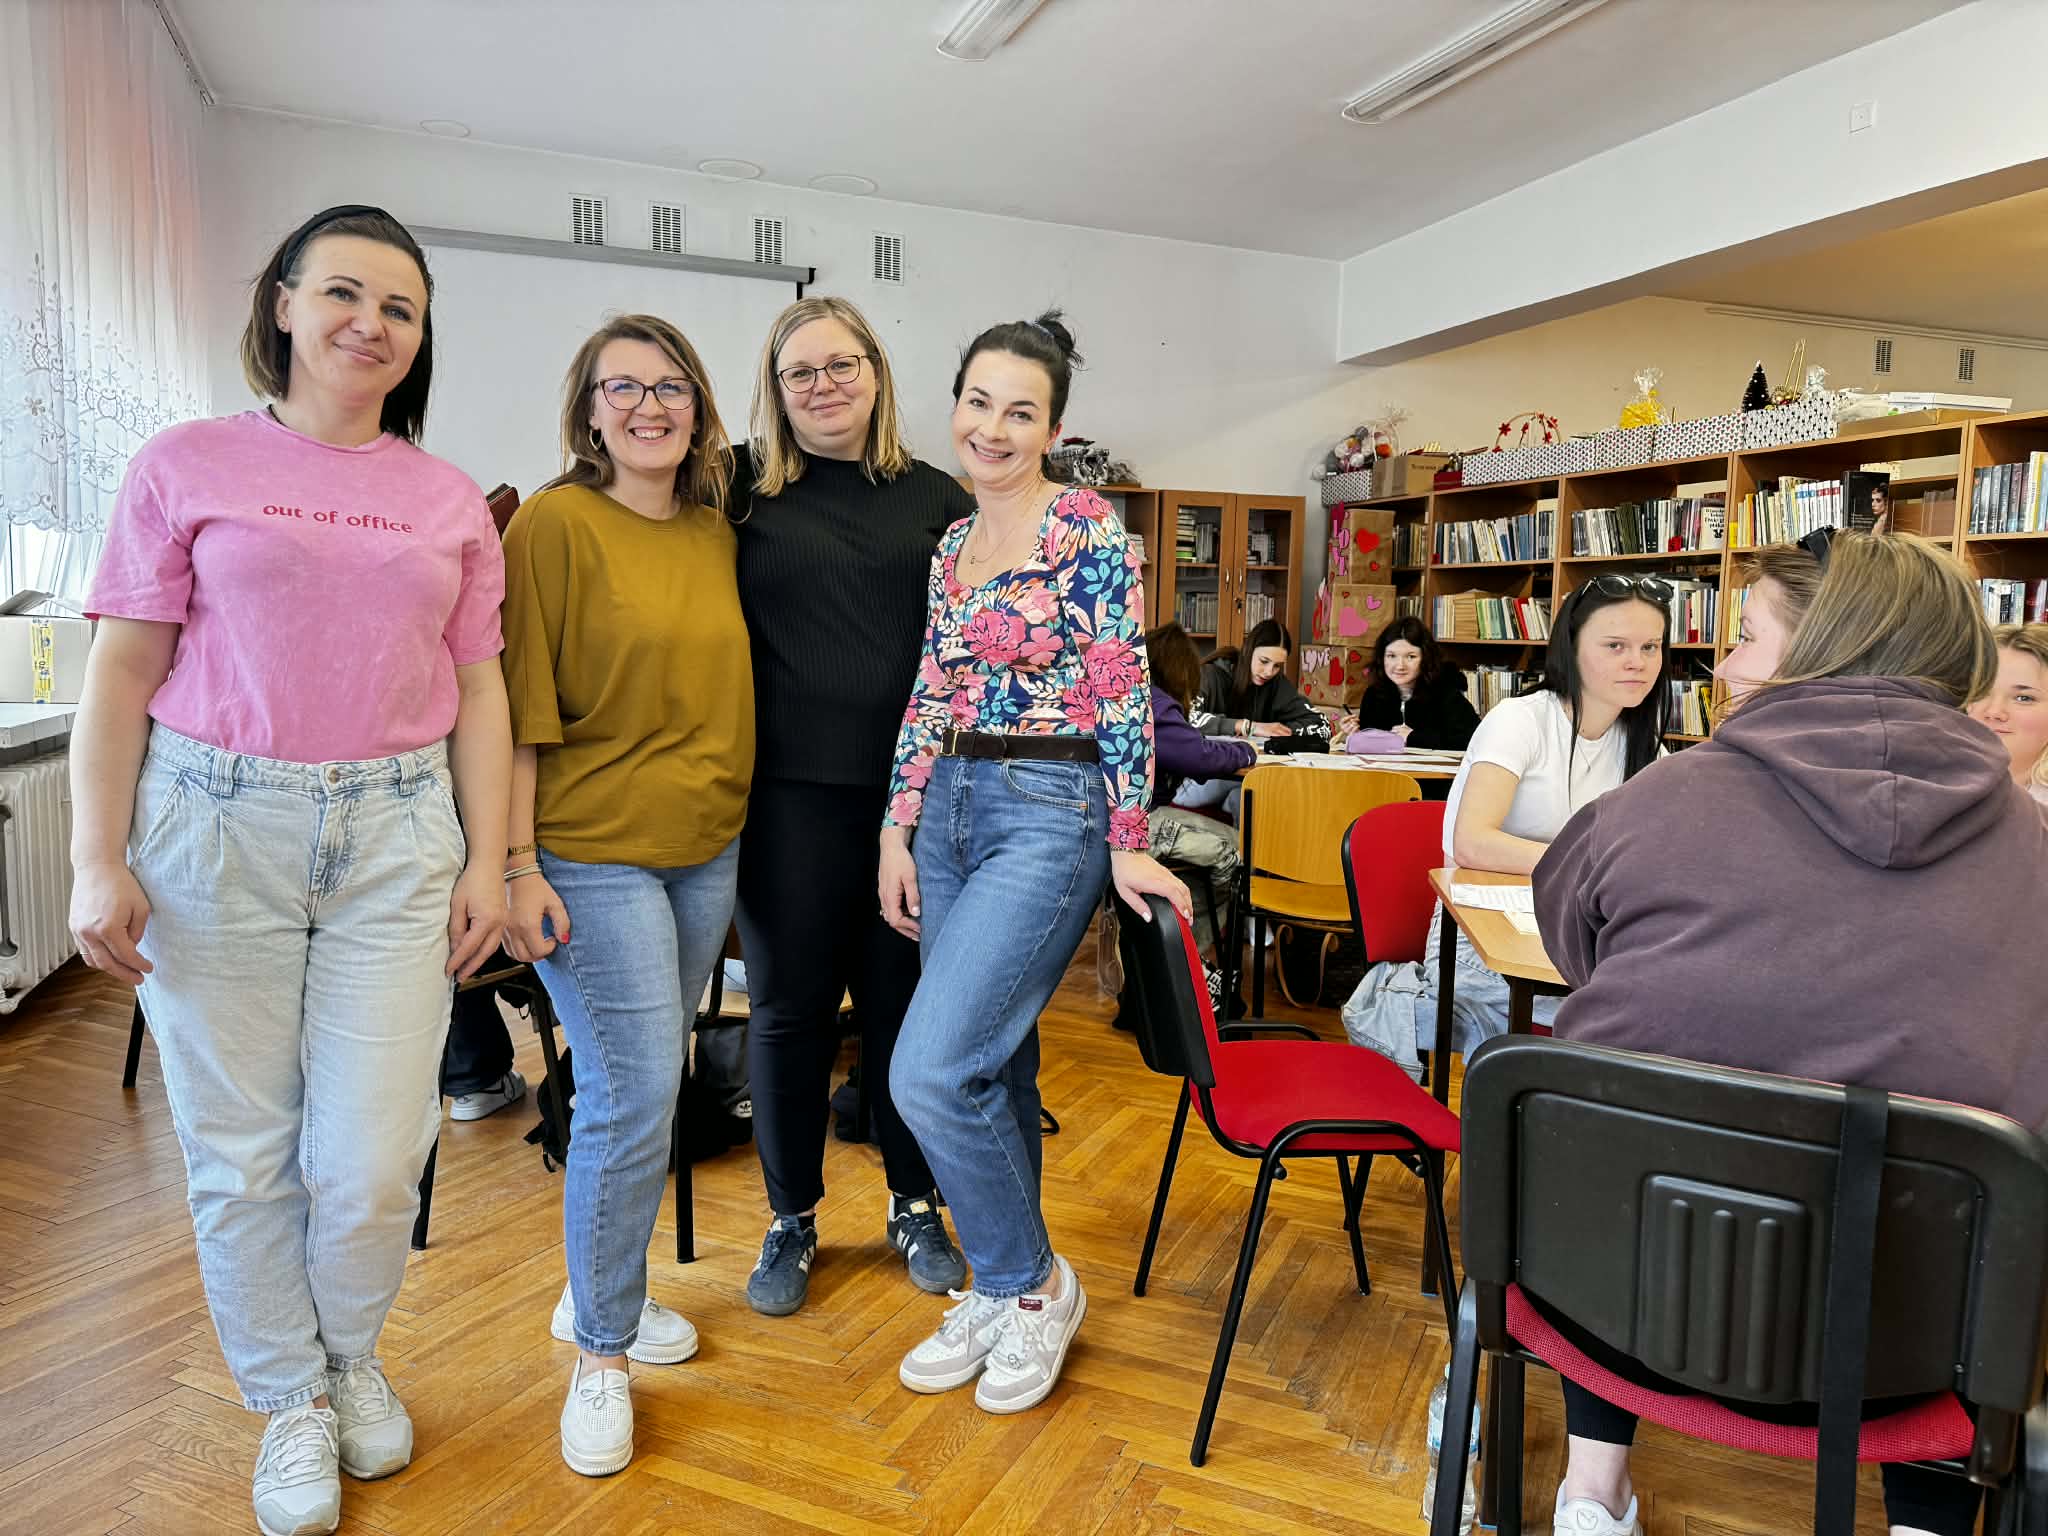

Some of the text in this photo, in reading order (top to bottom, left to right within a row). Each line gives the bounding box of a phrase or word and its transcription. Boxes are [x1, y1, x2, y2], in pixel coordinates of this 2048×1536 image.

[263, 504, 413, 533] out of office
[1300, 646, 1330, 673] LOVE
